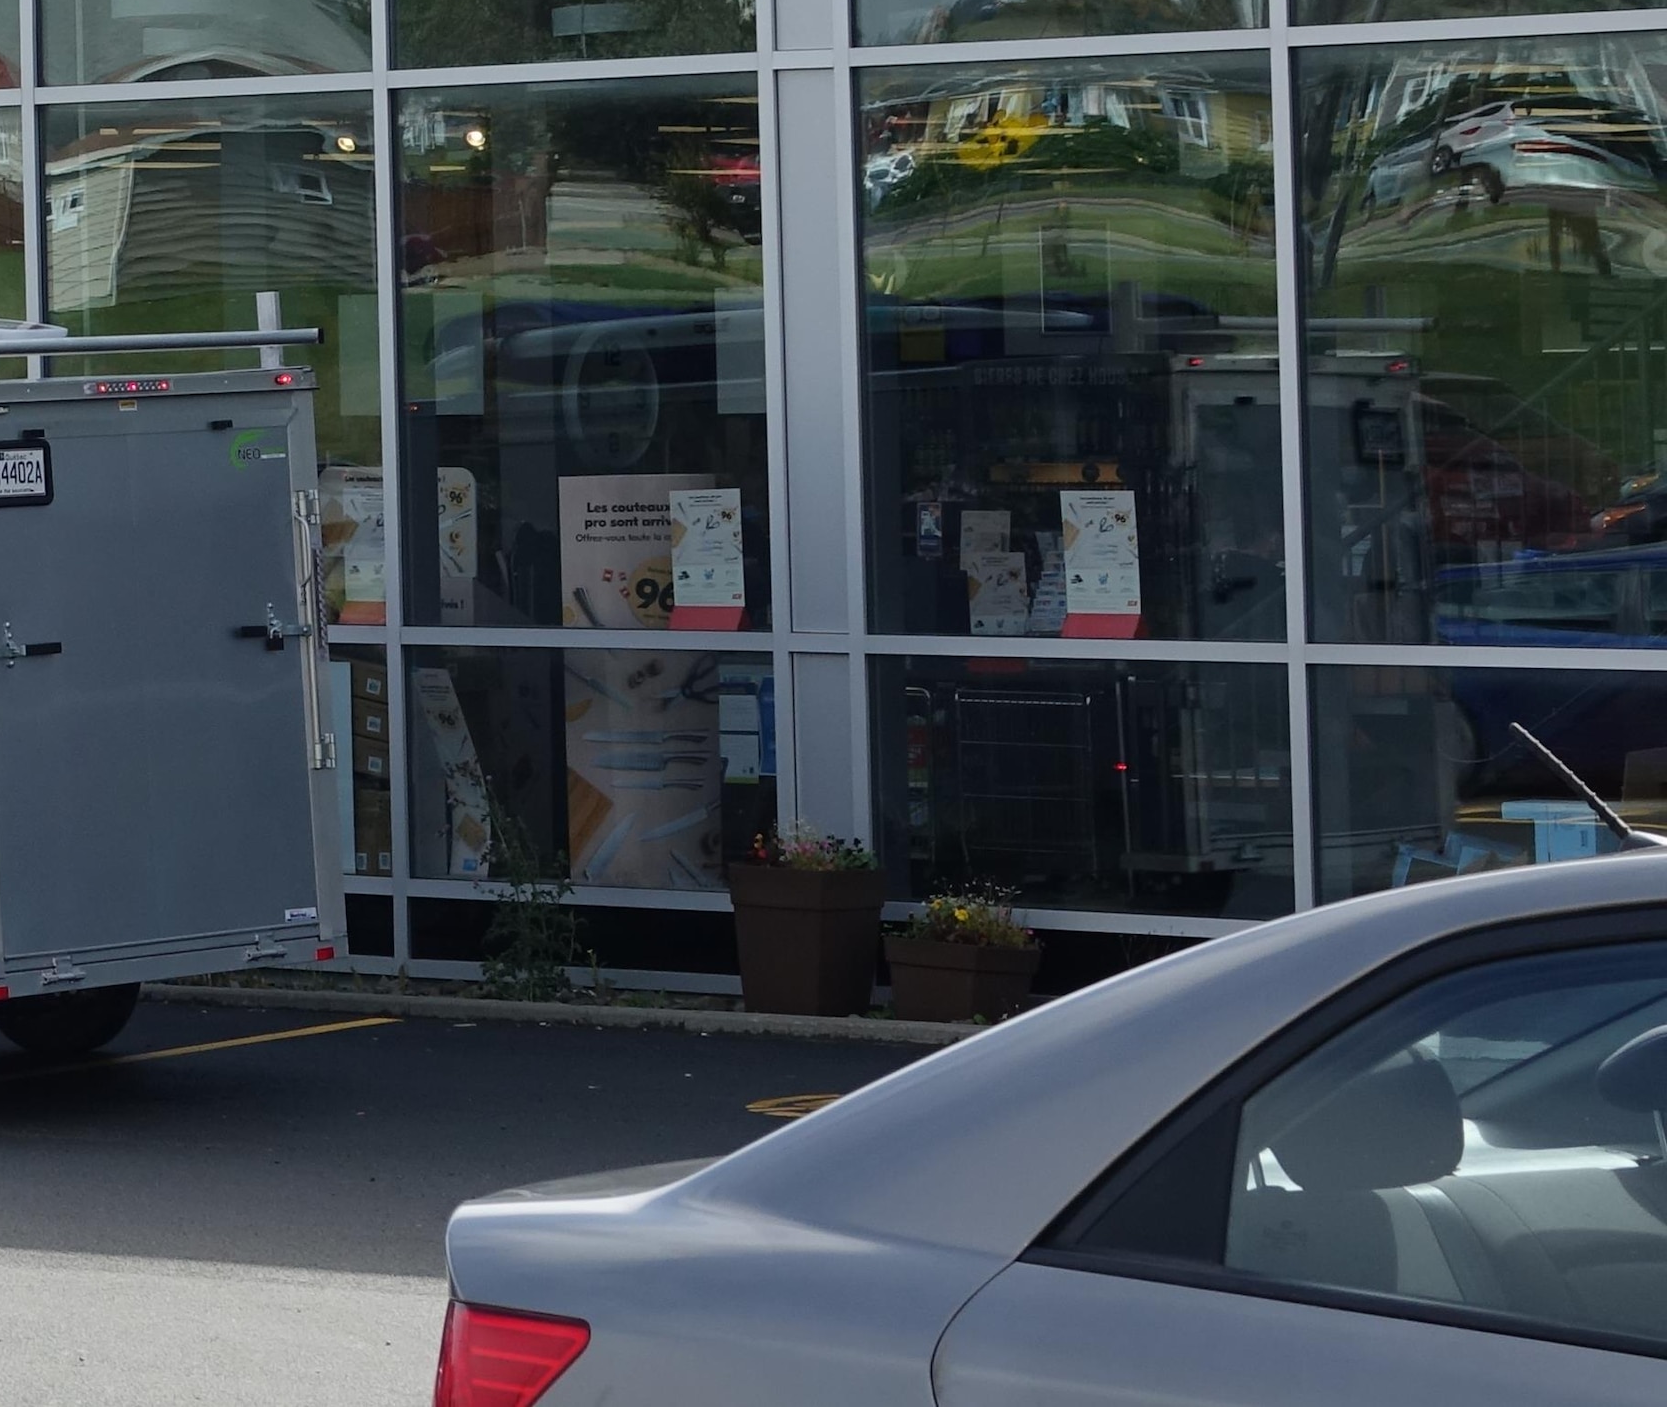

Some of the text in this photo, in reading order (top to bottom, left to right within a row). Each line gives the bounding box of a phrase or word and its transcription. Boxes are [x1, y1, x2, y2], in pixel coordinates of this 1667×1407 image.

[238, 448, 261, 460] NEO
[449, 490, 464, 505] 96
[586, 501, 608, 513] Les
[584, 518, 607, 531] pro
[609, 516, 639, 528] sont
[575, 533, 626, 543] Offrez-vous
[628, 533, 651, 542] toute
[635, 578, 674, 612] 96
